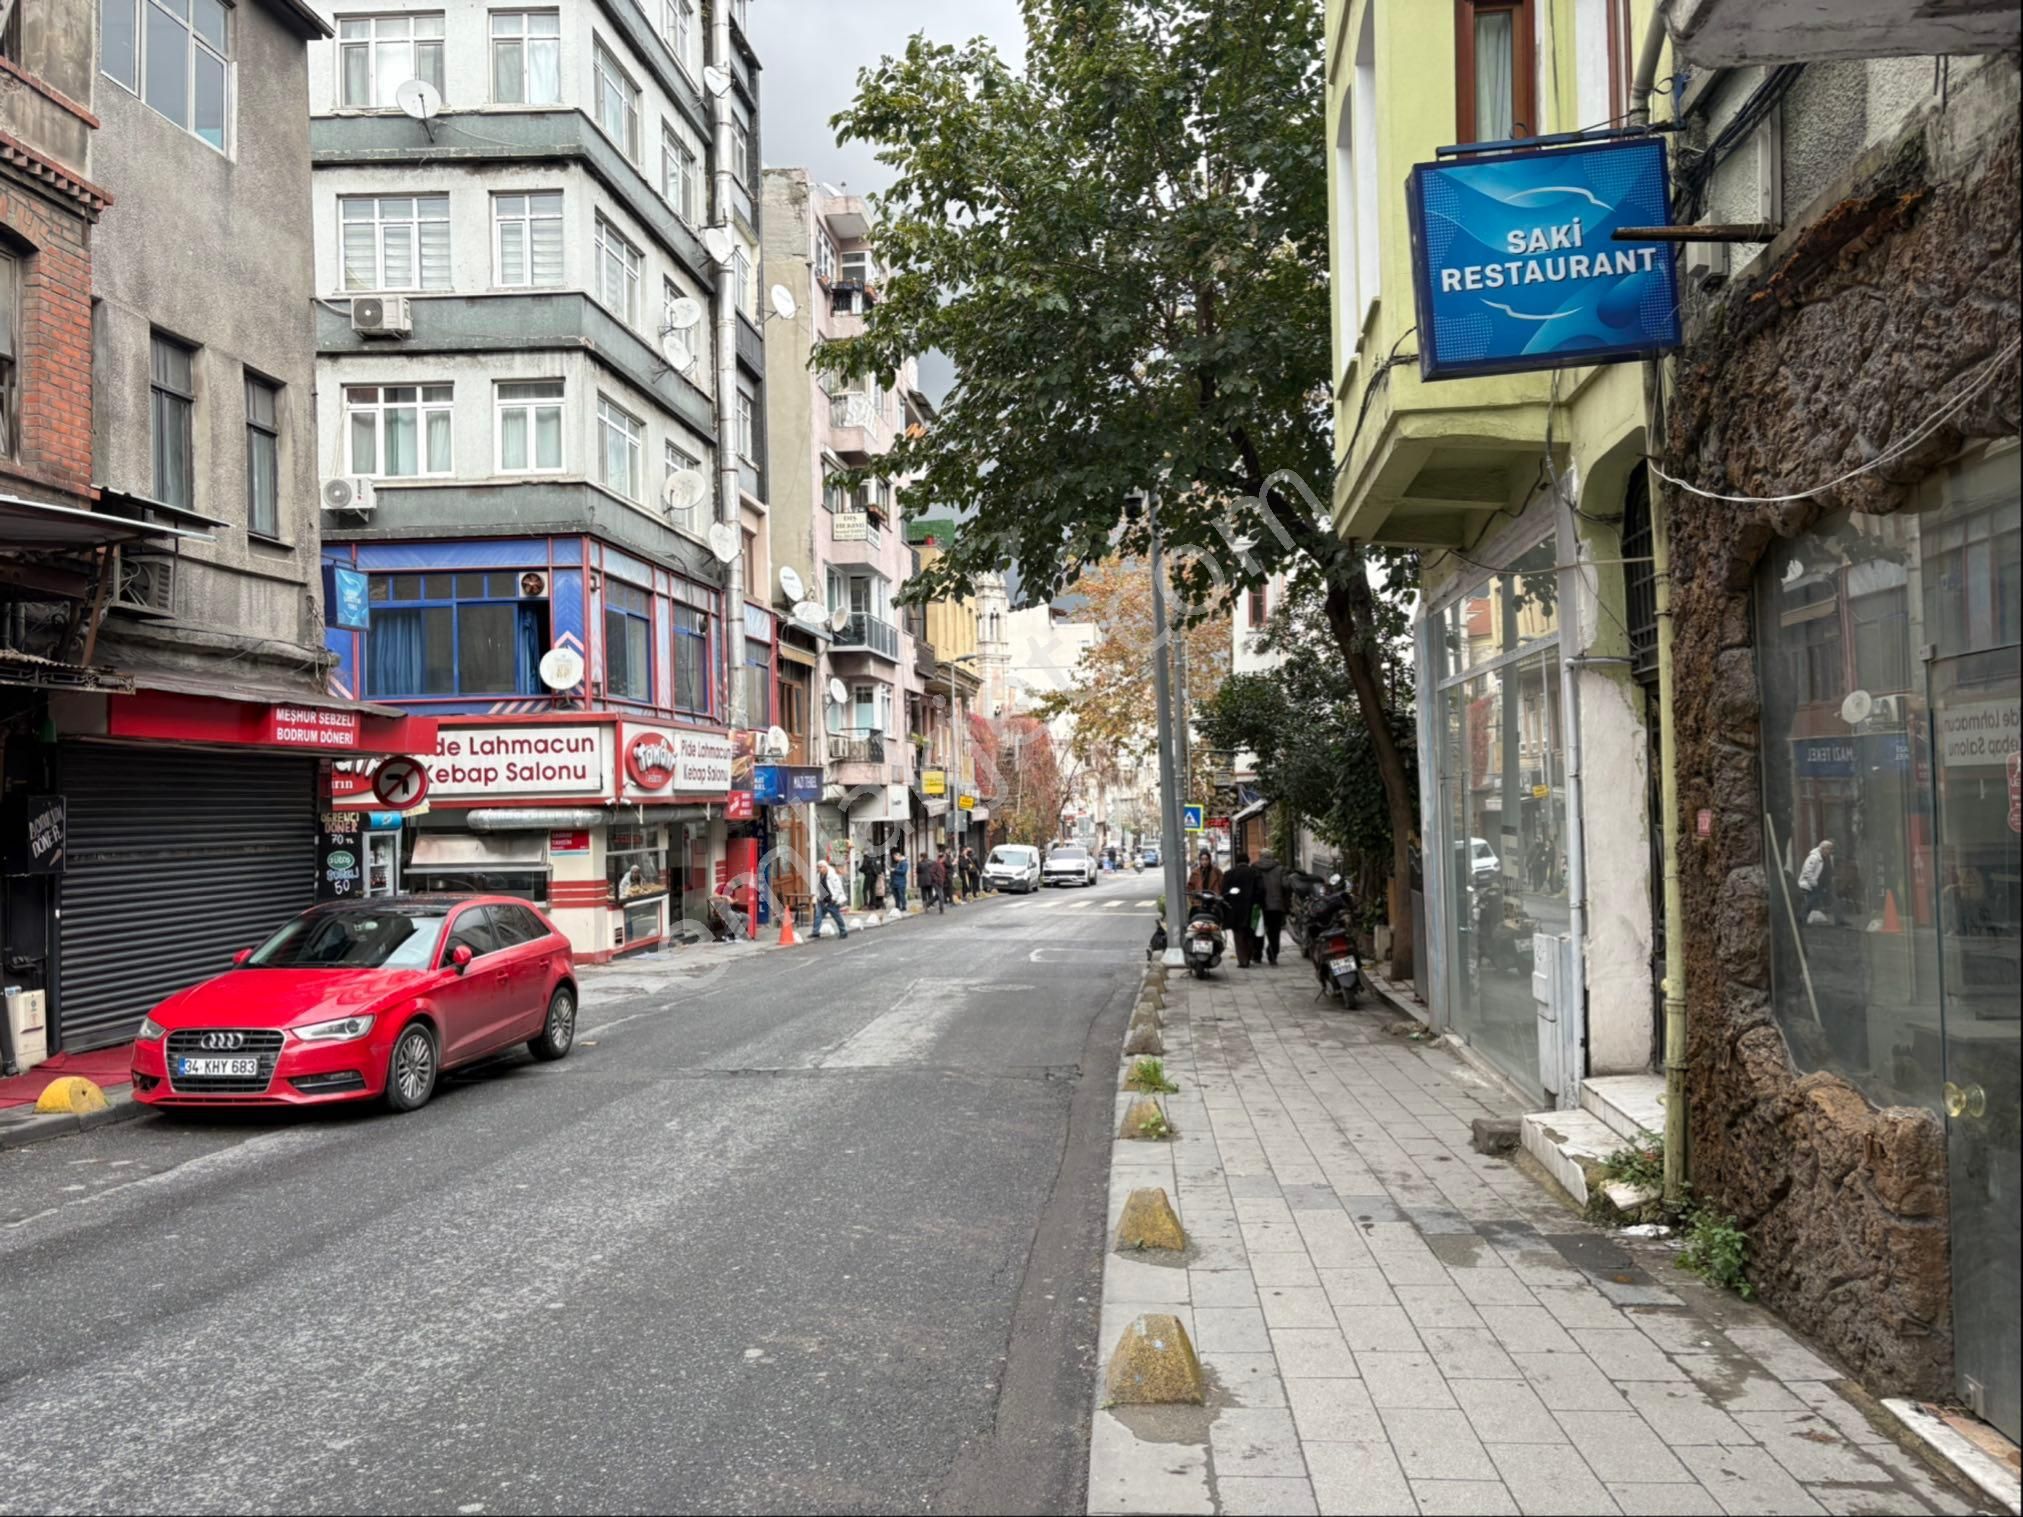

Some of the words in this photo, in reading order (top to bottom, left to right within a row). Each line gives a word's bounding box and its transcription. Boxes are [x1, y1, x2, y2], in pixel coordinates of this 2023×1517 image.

[1506, 216, 1584, 255] SAKİ
[1441, 247, 1658, 293] RESTAURANT
[275, 707, 317, 725] MEŞHUR
[318, 711, 355, 727] SEBZELİ
[276, 727, 318, 743] BODRUM
[320, 729, 354, 745] DÖNERİ
[434, 737, 461, 756] de
[469, 735, 595, 756] Lahmacun
[681, 739, 697, 758] Pide
[697, 741, 732, 760] Lahmacun
[506, 761, 587, 782] Salonu
[683, 764, 707, 784] Kebap
[707, 764, 729, 782] Salonu
[331, 833, 344, 845] 70
[334, 879, 351, 895] 50
[184, 1060, 199, 1073] 34
[204, 1060, 229, 1074] KHY
[231, 1060, 256, 1074] 683
